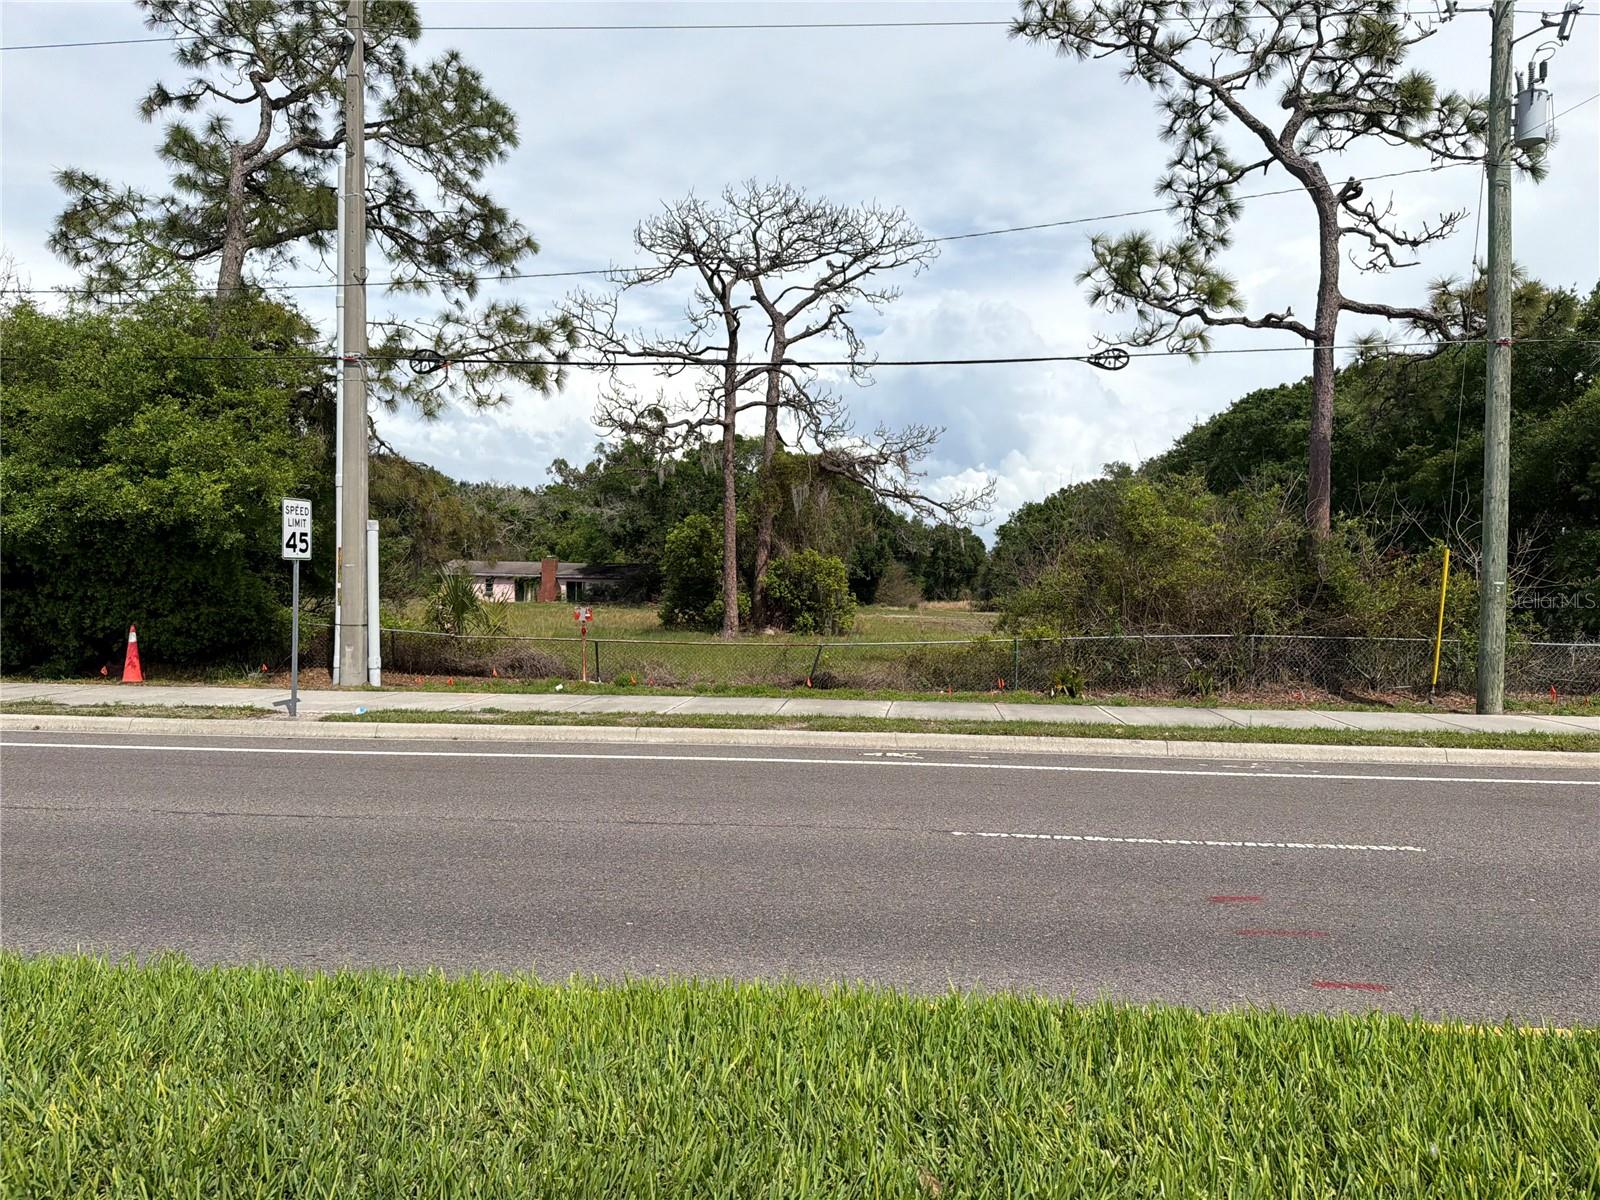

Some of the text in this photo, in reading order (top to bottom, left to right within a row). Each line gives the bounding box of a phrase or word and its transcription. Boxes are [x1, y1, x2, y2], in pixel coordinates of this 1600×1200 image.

[285, 505, 310, 516] SPEED
[288, 518, 307, 528] LIMIT
[285, 531, 309, 553] 45
